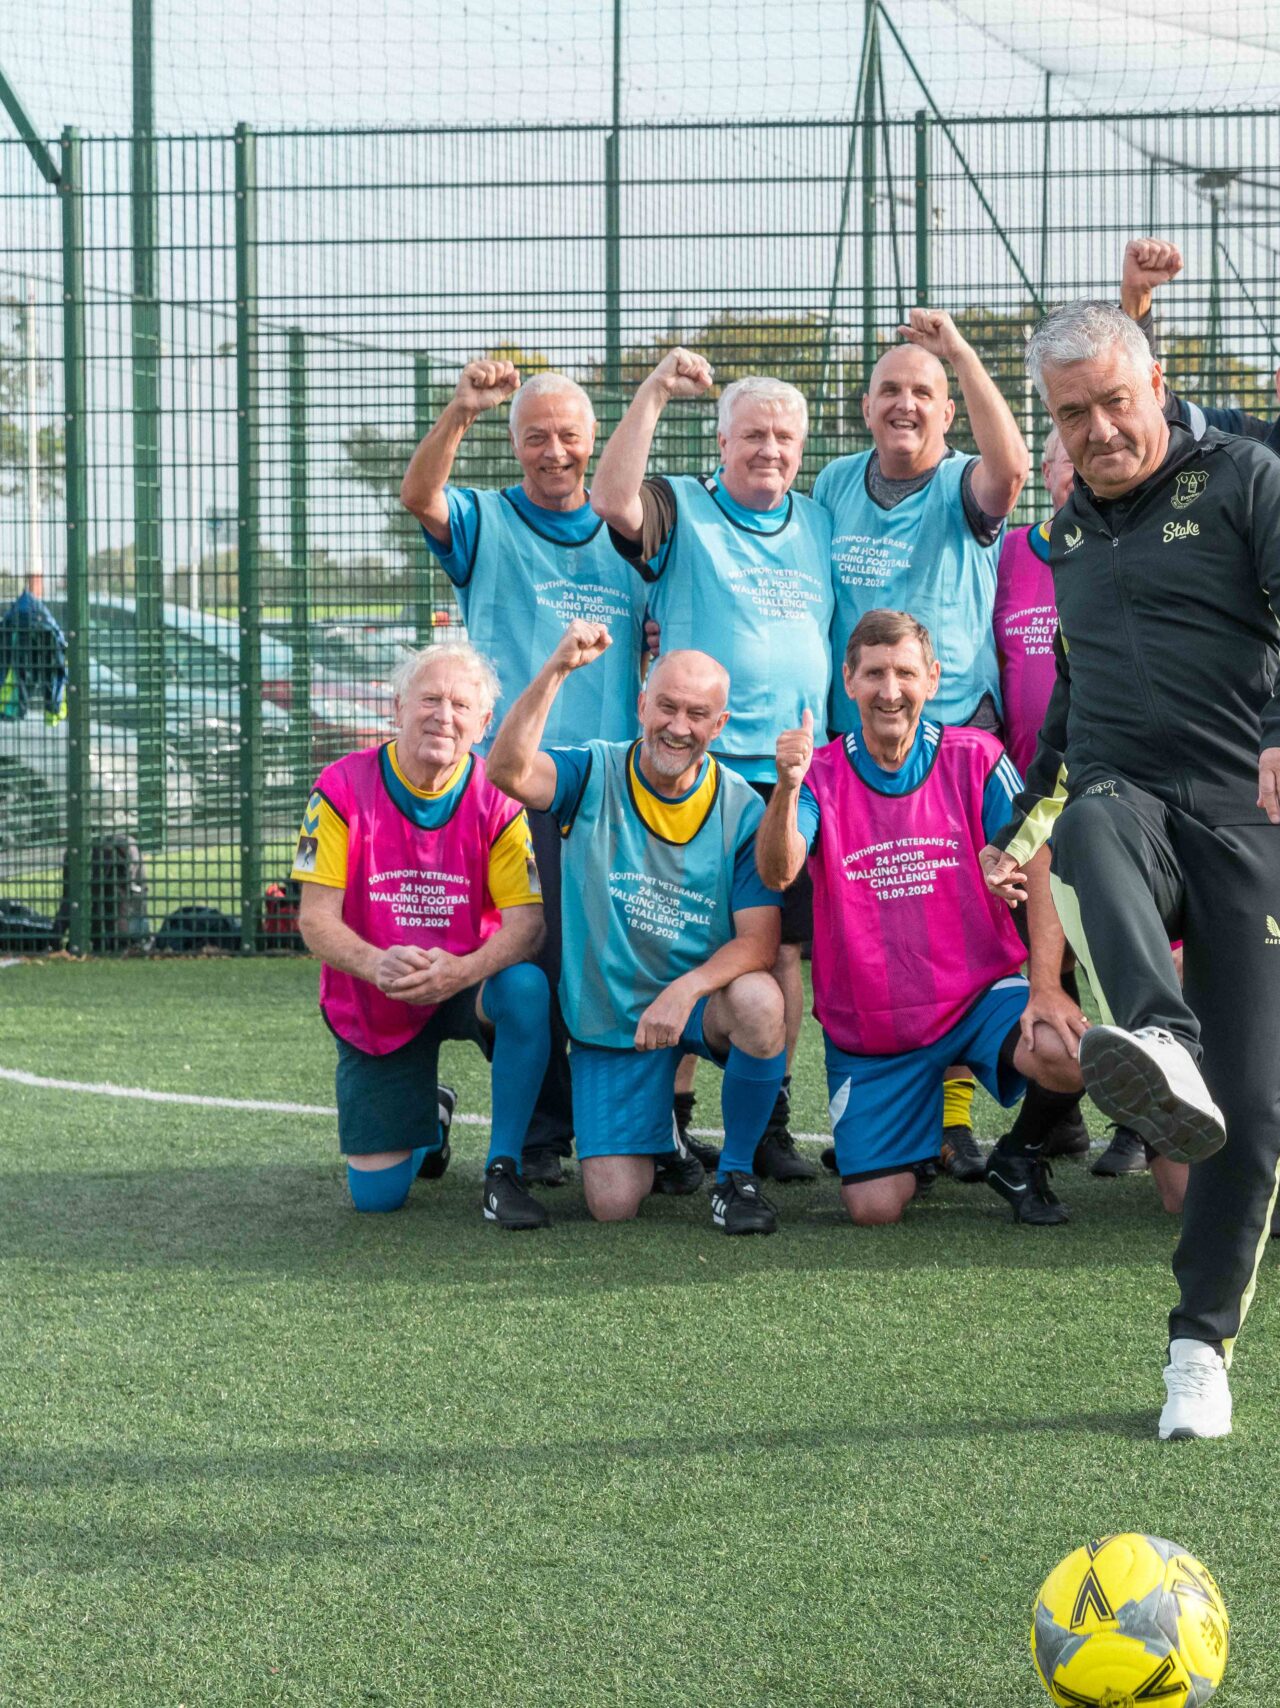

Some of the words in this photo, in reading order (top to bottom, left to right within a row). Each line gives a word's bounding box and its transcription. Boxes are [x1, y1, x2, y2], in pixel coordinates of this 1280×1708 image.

[1162, 519, 1200, 543] Stake
[832, 552, 864, 564] ALKING
[862, 548, 889, 558] HOUR
[839, 563, 892, 576] CHALLENGE
[562, 592, 574, 600] 24
[536, 596, 581, 611] WALKING
[584, 604, 630, 616] FOOTBALL
[1032, 617, 1043, 625] 24
[1005, 626, 1049, 636] WALKING
[842, 841, 894, 867] SOUTHPORT
[895, 837, 945, 847] VETERANS
[946, 839, 959, 850] FC
[876, 856, 889, 866] 24
[892, 850, 925, 864] HOUR
[368, 869, 418, 885] SOUTHPORT
[420, 871, 464, 884] VETERANS
[846, 865, 898, 881] WALKING
[901, 857, 959, 873] FOOTBALL
[870, 870, 937, 888] CHALLENGE
[400, 883, 412, 892] 24
[415, 884, 445, 895] HOUR
[637, 886, 651, 897] 24
[658, 881, 704, 902] VETERANS
[704, 898, 717, 909] FC
[876, 884, 934, 900] 18.09.2024
[369, 892, 419, 903] WALKING
[608, 886, 655, 909] WALKING
[657, 905, 711, 925] FOOTBALL
[391, 904, 454, 915] CHALLENGE
[624, 904, 686, 930] CHALLENGE
[395, 917, 450, 927] 18.09.2024
[626, 917, 679, 940] 18.09.2024
